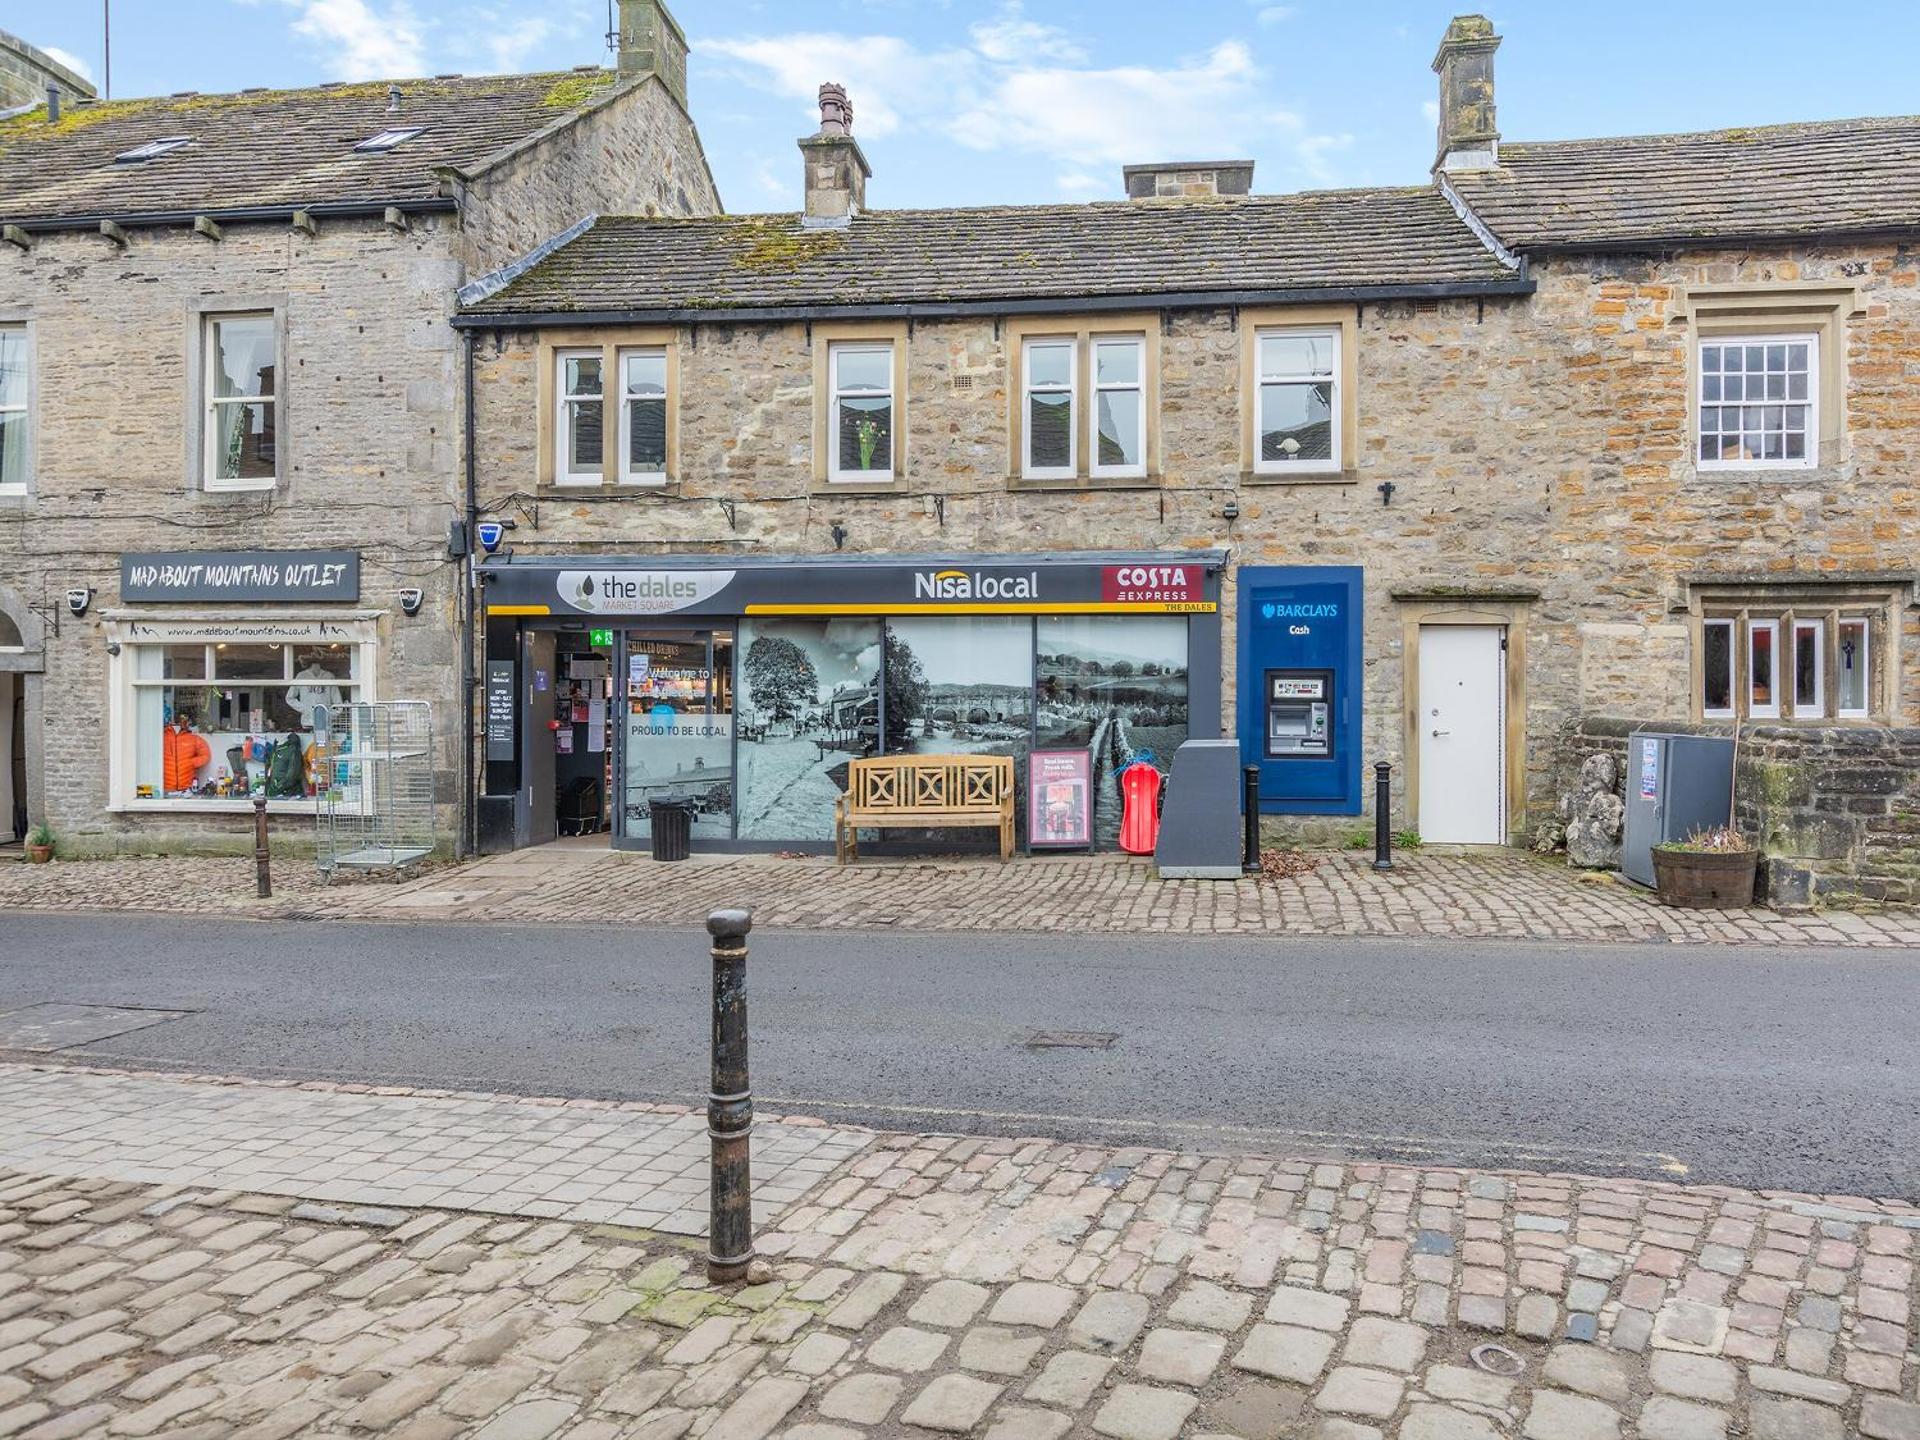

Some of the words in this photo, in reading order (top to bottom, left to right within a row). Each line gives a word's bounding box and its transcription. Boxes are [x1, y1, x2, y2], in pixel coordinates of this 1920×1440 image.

[130, 565, 157, 587] MAD
[158, 565, 203, 587] ABOUT
[204, 564, 279, 587] MOUNTAINS
[285, 563, 347, 587] OUTLET
[1116, 567, 1188, 588] COSTA
[602, 575, 637, 598] the
[639, 575, 697, 598] dales
[1128, 591, 1188, 600] EXPRESS
[602, 600, 637, 610] MARKET
[639, 600, 675, 611] SQUARE
[1165, 603, 1183, 612] THE
[1184, 603, 1213, 612] DALES
[1276, 604, 1338, 617] BARCLAYS
[1289, 624, 1310, 635] Cash
[649, 667, 697, 679] Welcome
[699, 667, 710, 679] to
[631, 725, 664, 736] PROUD
[667, 725, 679, 736] TO
[681, 725, 694, 736] BE
[695, 726, 727, 737] LOCAL
